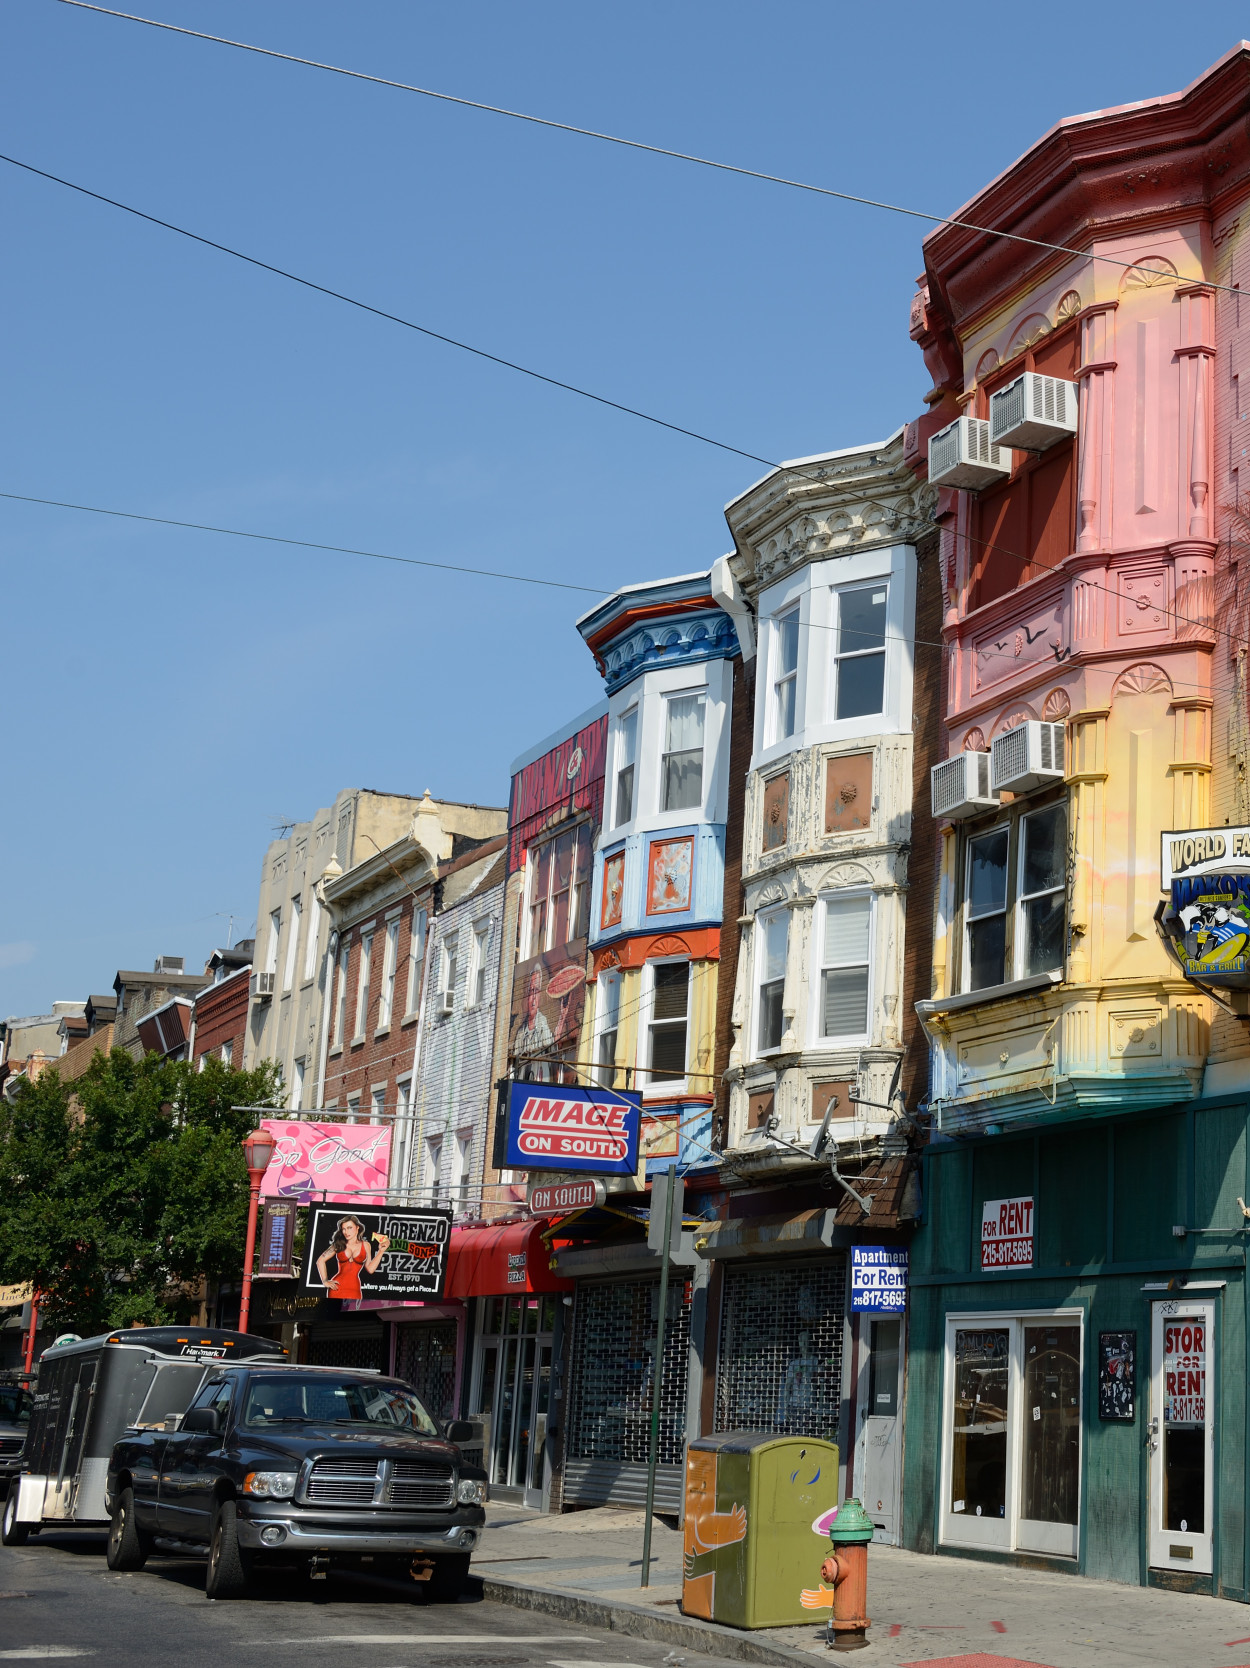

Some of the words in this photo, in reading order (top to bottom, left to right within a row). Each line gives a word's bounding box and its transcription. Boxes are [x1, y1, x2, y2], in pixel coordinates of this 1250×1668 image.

[1170, 834, 1227, 873] WORLD
[1189, 960, 1207, 973] BAR
[1209, 964, 1217, 972] &
[1218, 960, 1242, 971] GRILL
[521, 1098, 630, 1129] IMAGE
[268, 1137, 302, 1167] So
[308, 1127, 389, 1173] Good
[525, 1136, 551, 1150] ON
[560, 1138, 621, 1156] SOUTH
[534, 1191, 550, 1208] ON
[554, 1185, 593, 1206] SOUTH
[377, 1213, 449, 1244] LORENZO
[983, 1220, 997, 1237] FOR
[999, 1201, 1033, 1236] RENT
[375, 1251, 442, 1276] PIZZA
[854, 1249, 909, 1266] Apartment
[982, 1240, 1033, 1265] 215-817-5695
[388, 1273, 402, 1281] EST.
[403, 1274, 420, 1283] 1970
[854, 1269, 876, 1286] For
[878, 1269, 908, 1286] Rent
[1165, 1326, 1206, 1354] STOR
[1176, 1355, 1200, 1368] FOR
